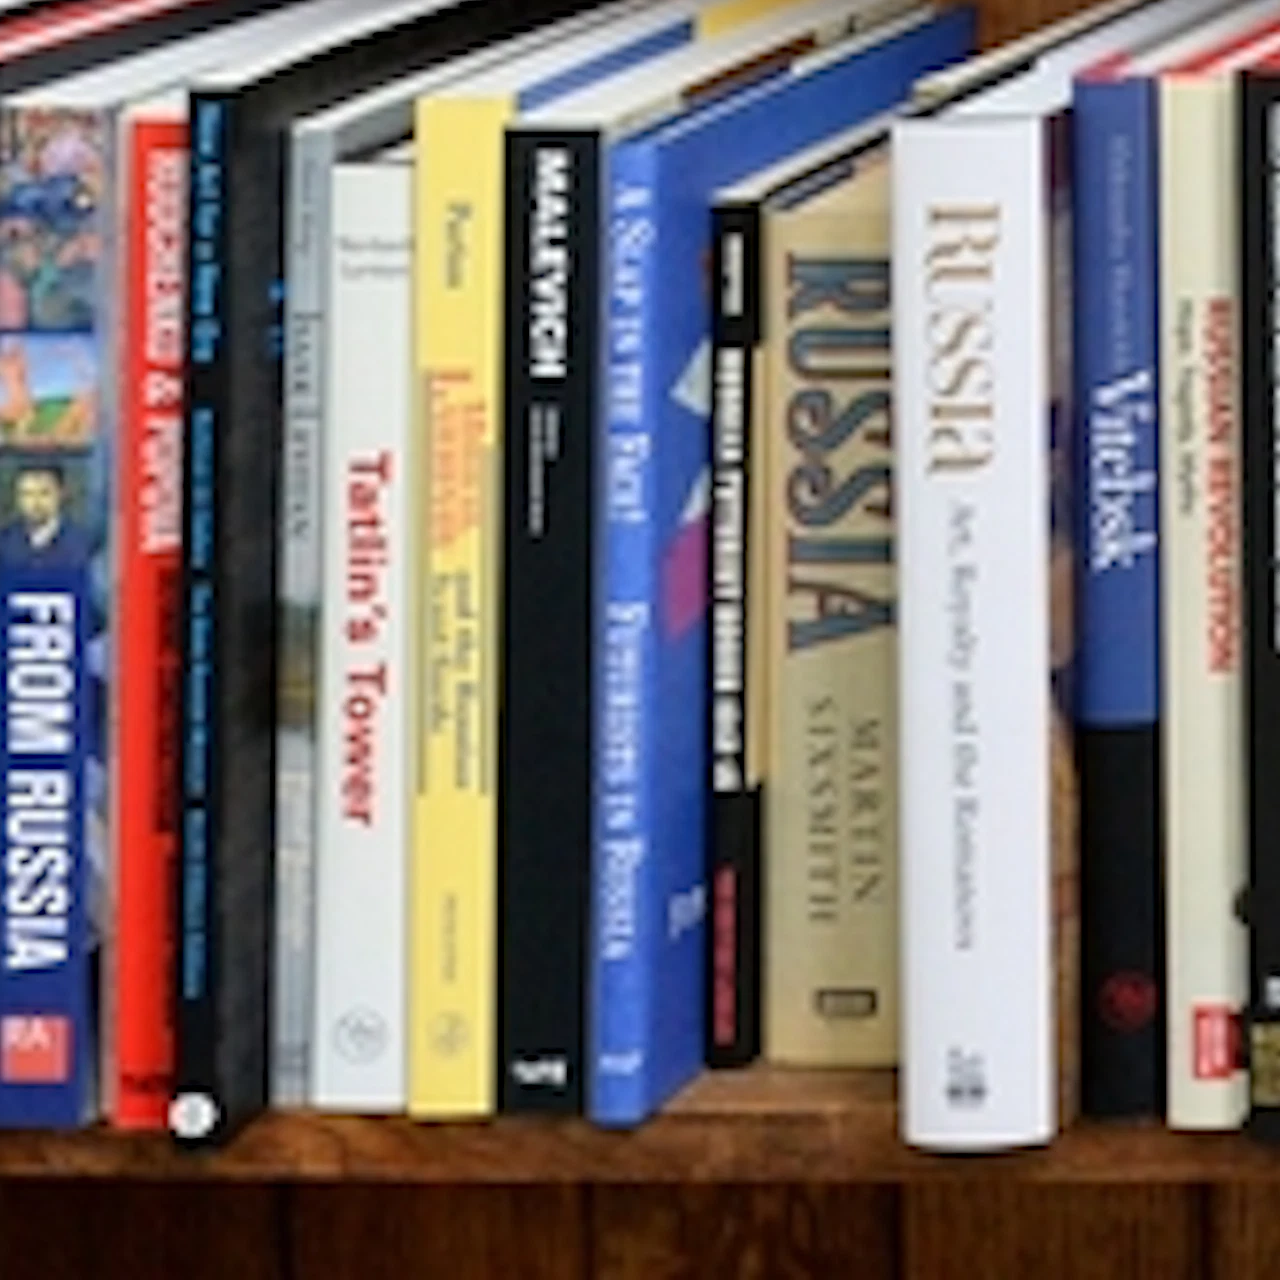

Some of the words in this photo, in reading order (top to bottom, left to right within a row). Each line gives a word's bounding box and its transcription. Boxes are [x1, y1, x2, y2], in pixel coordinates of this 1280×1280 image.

[528, 147, 570, 380] MALEVICH
[608, 185, 653, 212] A
[786, 252, 894, 657] RUSSIA
[1207, 297, 1235, 442] RUSSIAN
[344, 450, 396, 642] Tatlin's
[1092, 368, 1157, 572] Vitebsk
[1207, 457, 1236, 674] REVOLUTION
[5, 593, 73, 754] FROM
[344, 660, 396, 830] Tower
[4, 769, 73, 971] RUSSIA
[806, 695, 841, 927] SIXSMITH
[849, 717, 882, 902] MARTIN
